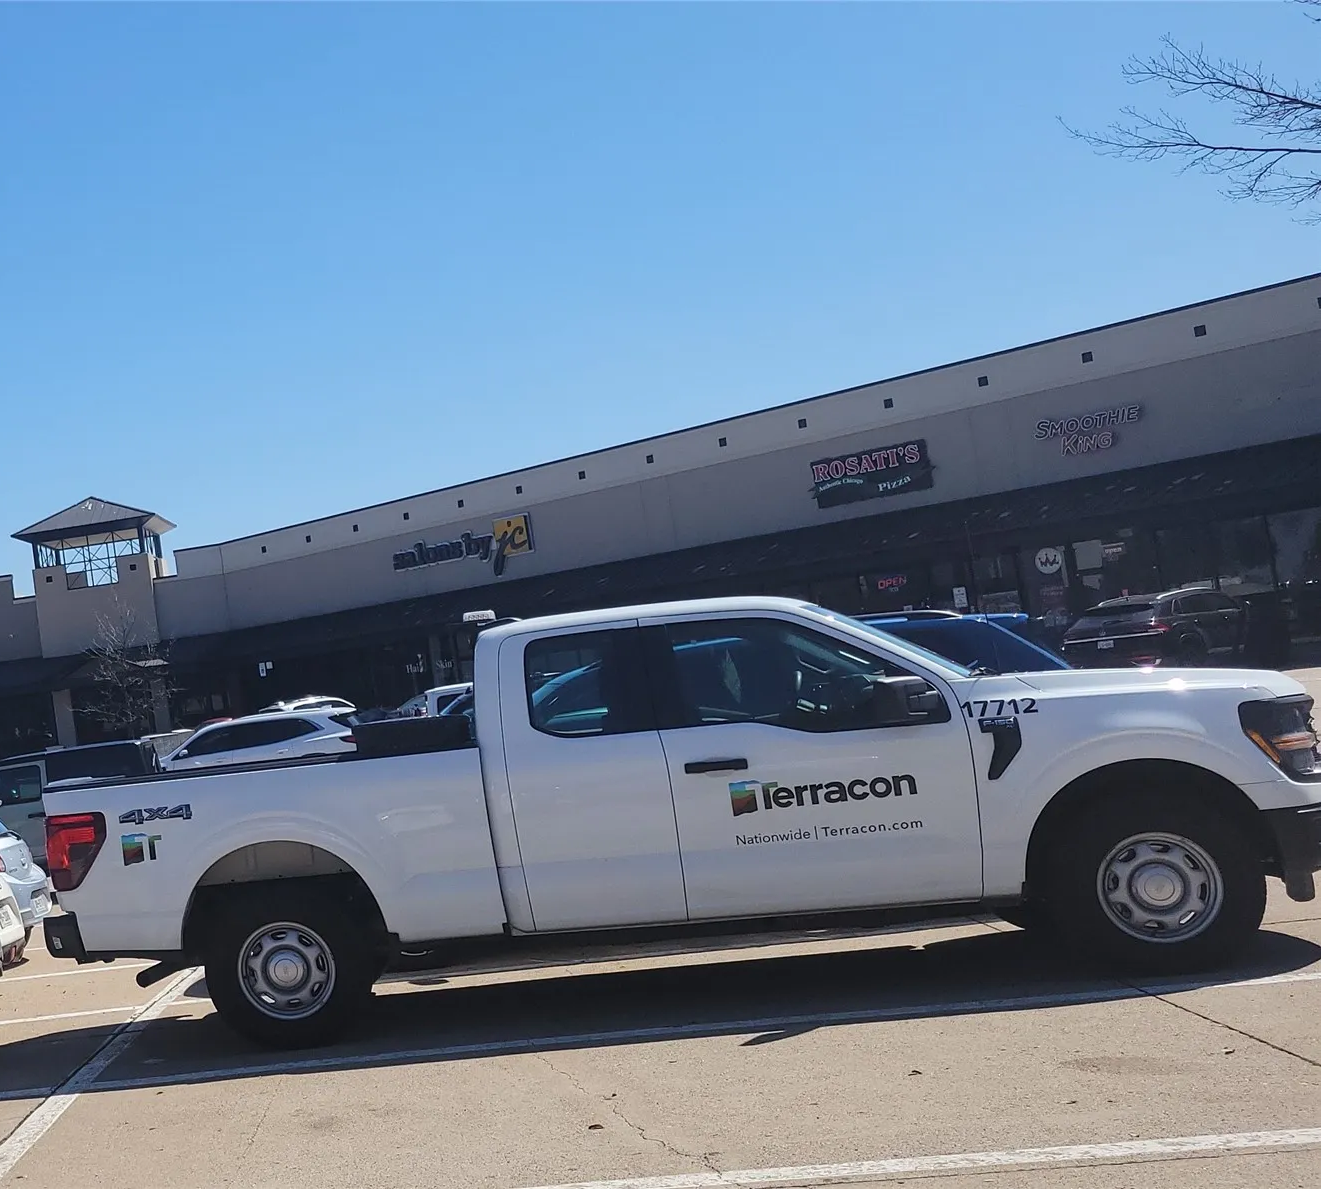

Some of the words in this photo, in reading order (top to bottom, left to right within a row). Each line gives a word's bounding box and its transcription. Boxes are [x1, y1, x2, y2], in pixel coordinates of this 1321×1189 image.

[1035, 405, 1139, 440] SMOOTHIE
[812, 444, 920, 482] ROSATI'S
[878, 475, 911, 492] Pizza
[877, 576, 907, 590] OPEN
[436, 659, 453, 669] Skin
[961, 697, 1039, 718] 17712
[759, 774, 918, 810] Terracon
[735, 826, 811, 846] Nationwide
[821, 819, 923, 839] Terracon.com
